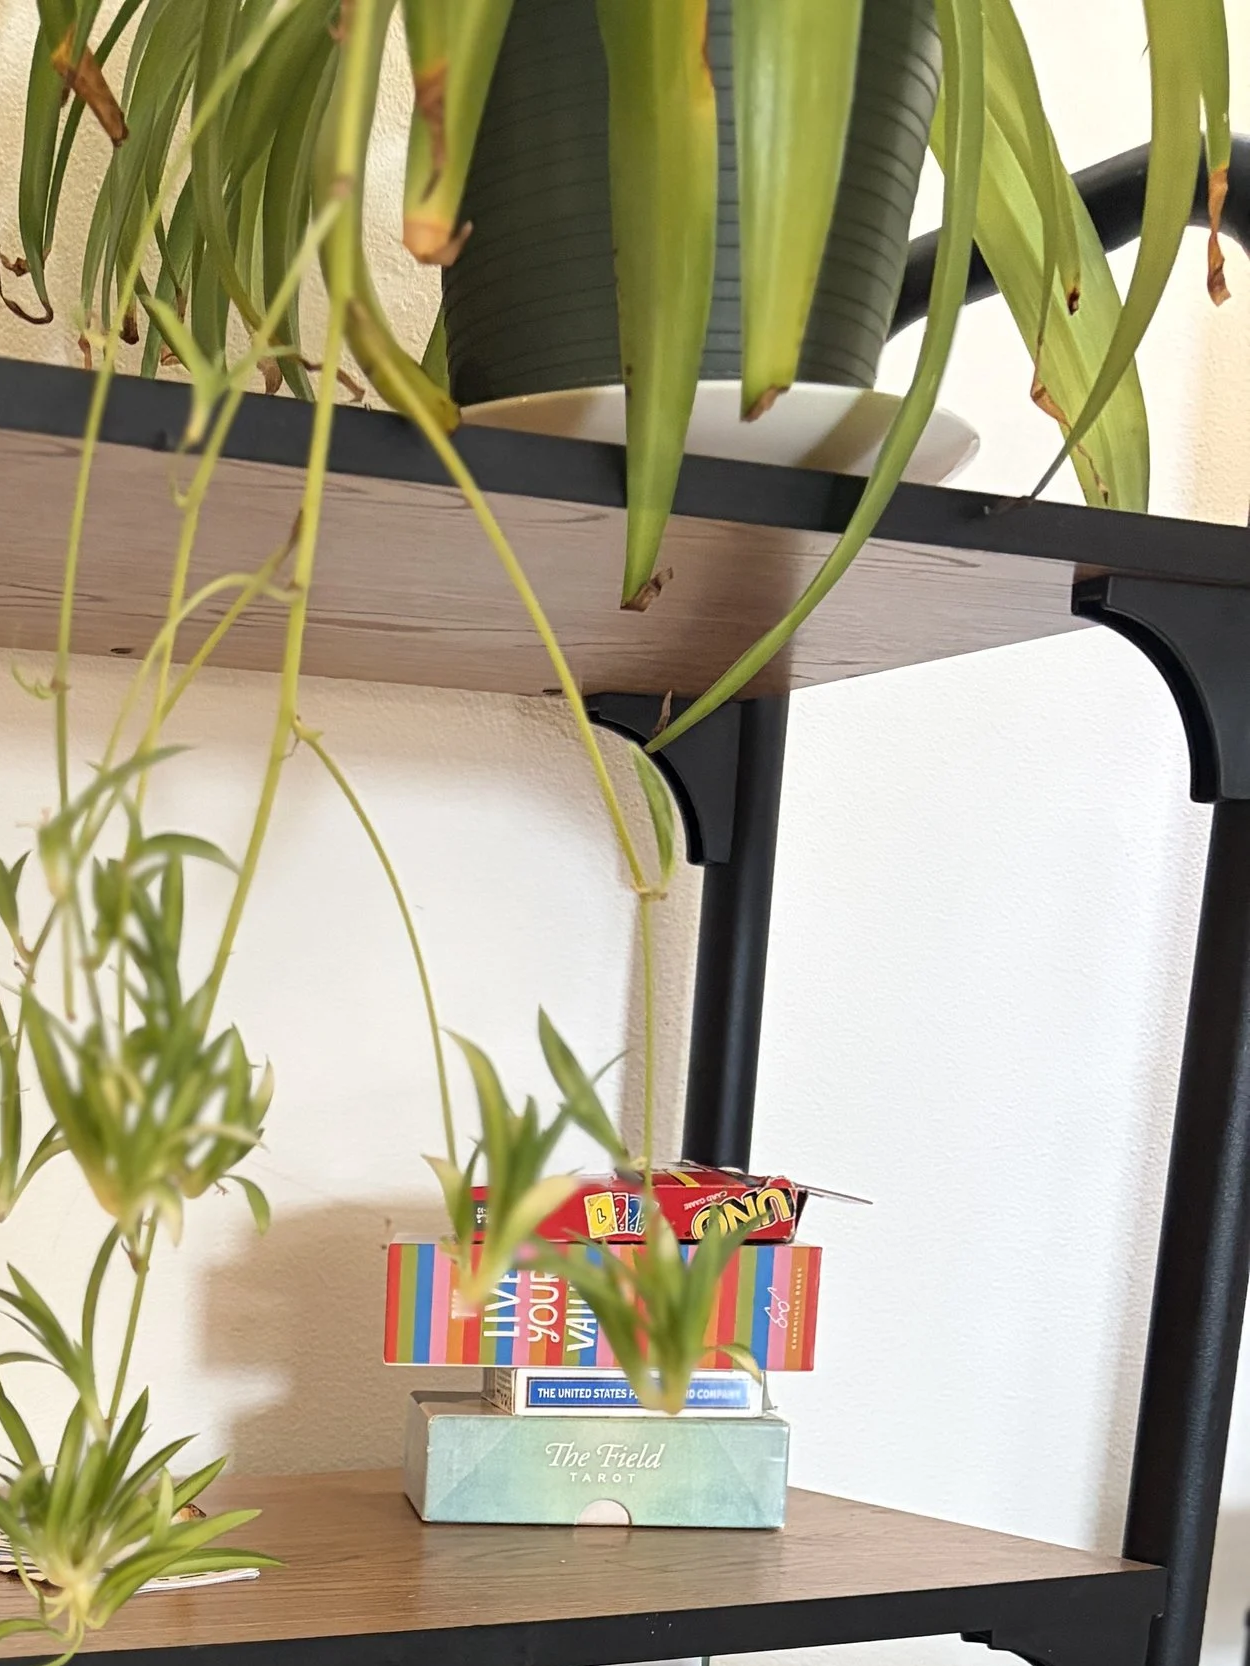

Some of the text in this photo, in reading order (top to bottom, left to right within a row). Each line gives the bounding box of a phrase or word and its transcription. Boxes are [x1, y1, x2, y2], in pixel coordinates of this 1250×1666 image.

[691, 1186, 795, 1240] UNO
[537, 1387, 555, 1398] THE
[558, 1387, 592, 1398] UNITED
[593, 1388, 627, 1399] STATES
[545, 1441, 667, 1470] The Field
[569, 1472, 637, 1485] TAROT
